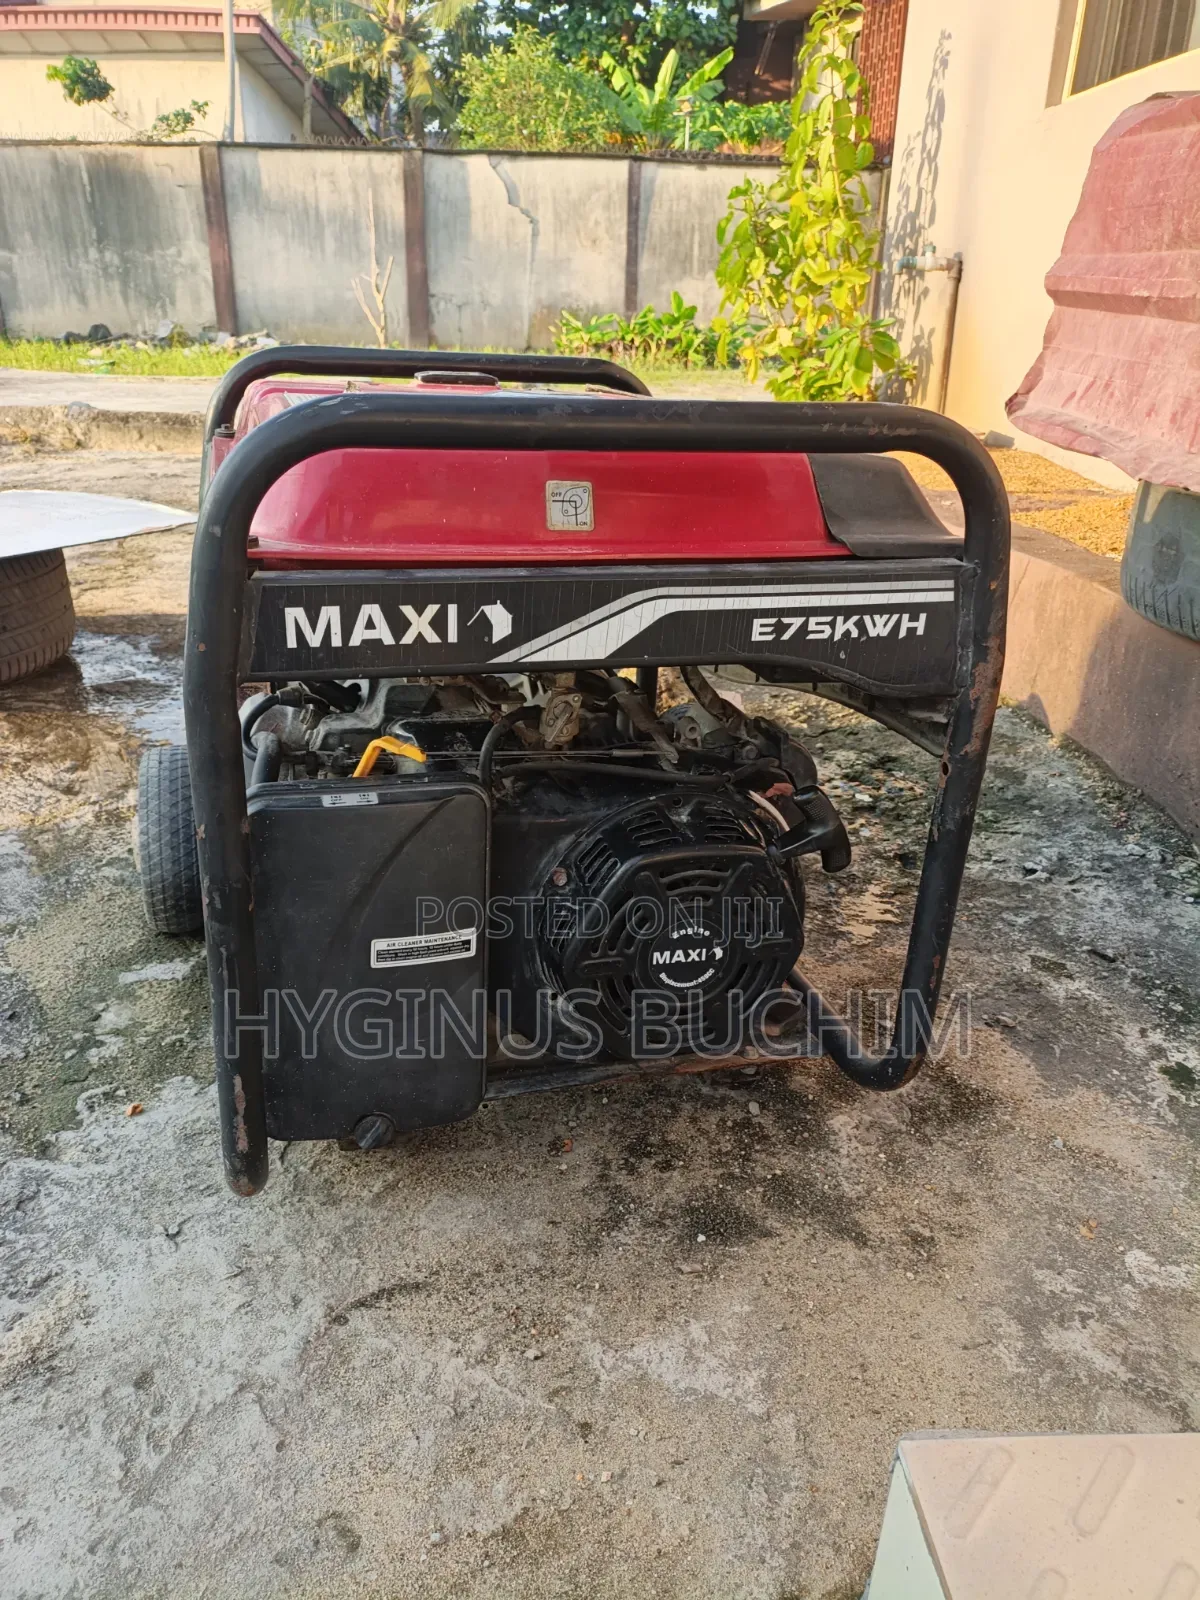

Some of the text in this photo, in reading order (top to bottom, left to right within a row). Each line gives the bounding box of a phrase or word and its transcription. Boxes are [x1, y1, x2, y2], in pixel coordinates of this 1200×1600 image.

[284, 604, 927, 648] MAXI E75KWH
[424, 934, 462, 944] MAINTENANCE
[672, 925, 710, 939] Engine
[652, 948, 706, 965] MAXI
